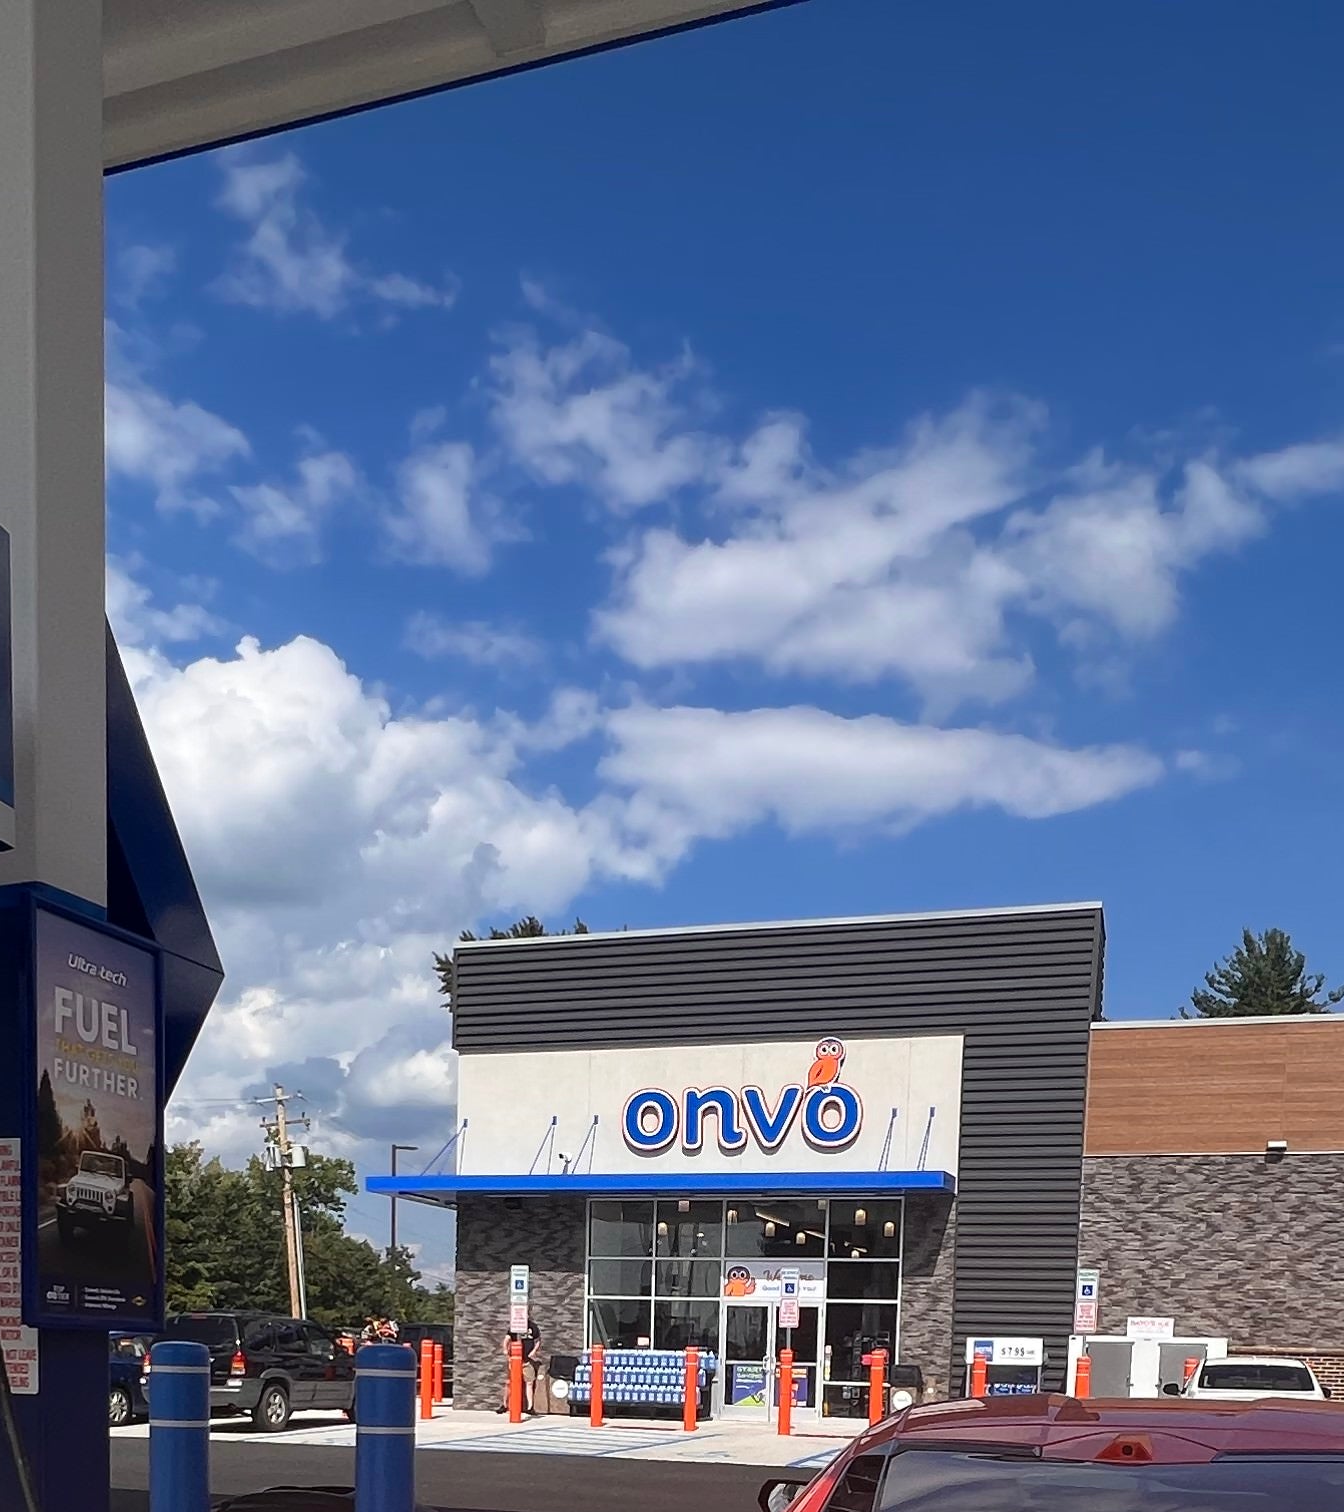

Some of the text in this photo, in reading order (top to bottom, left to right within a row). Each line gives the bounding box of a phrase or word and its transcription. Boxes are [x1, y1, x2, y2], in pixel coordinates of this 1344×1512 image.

[55, 986, 137, 1056] FUEL
[54, 1057, 144, 1101] FURTHER.
[624, 1083, 862, 1151] onvo
